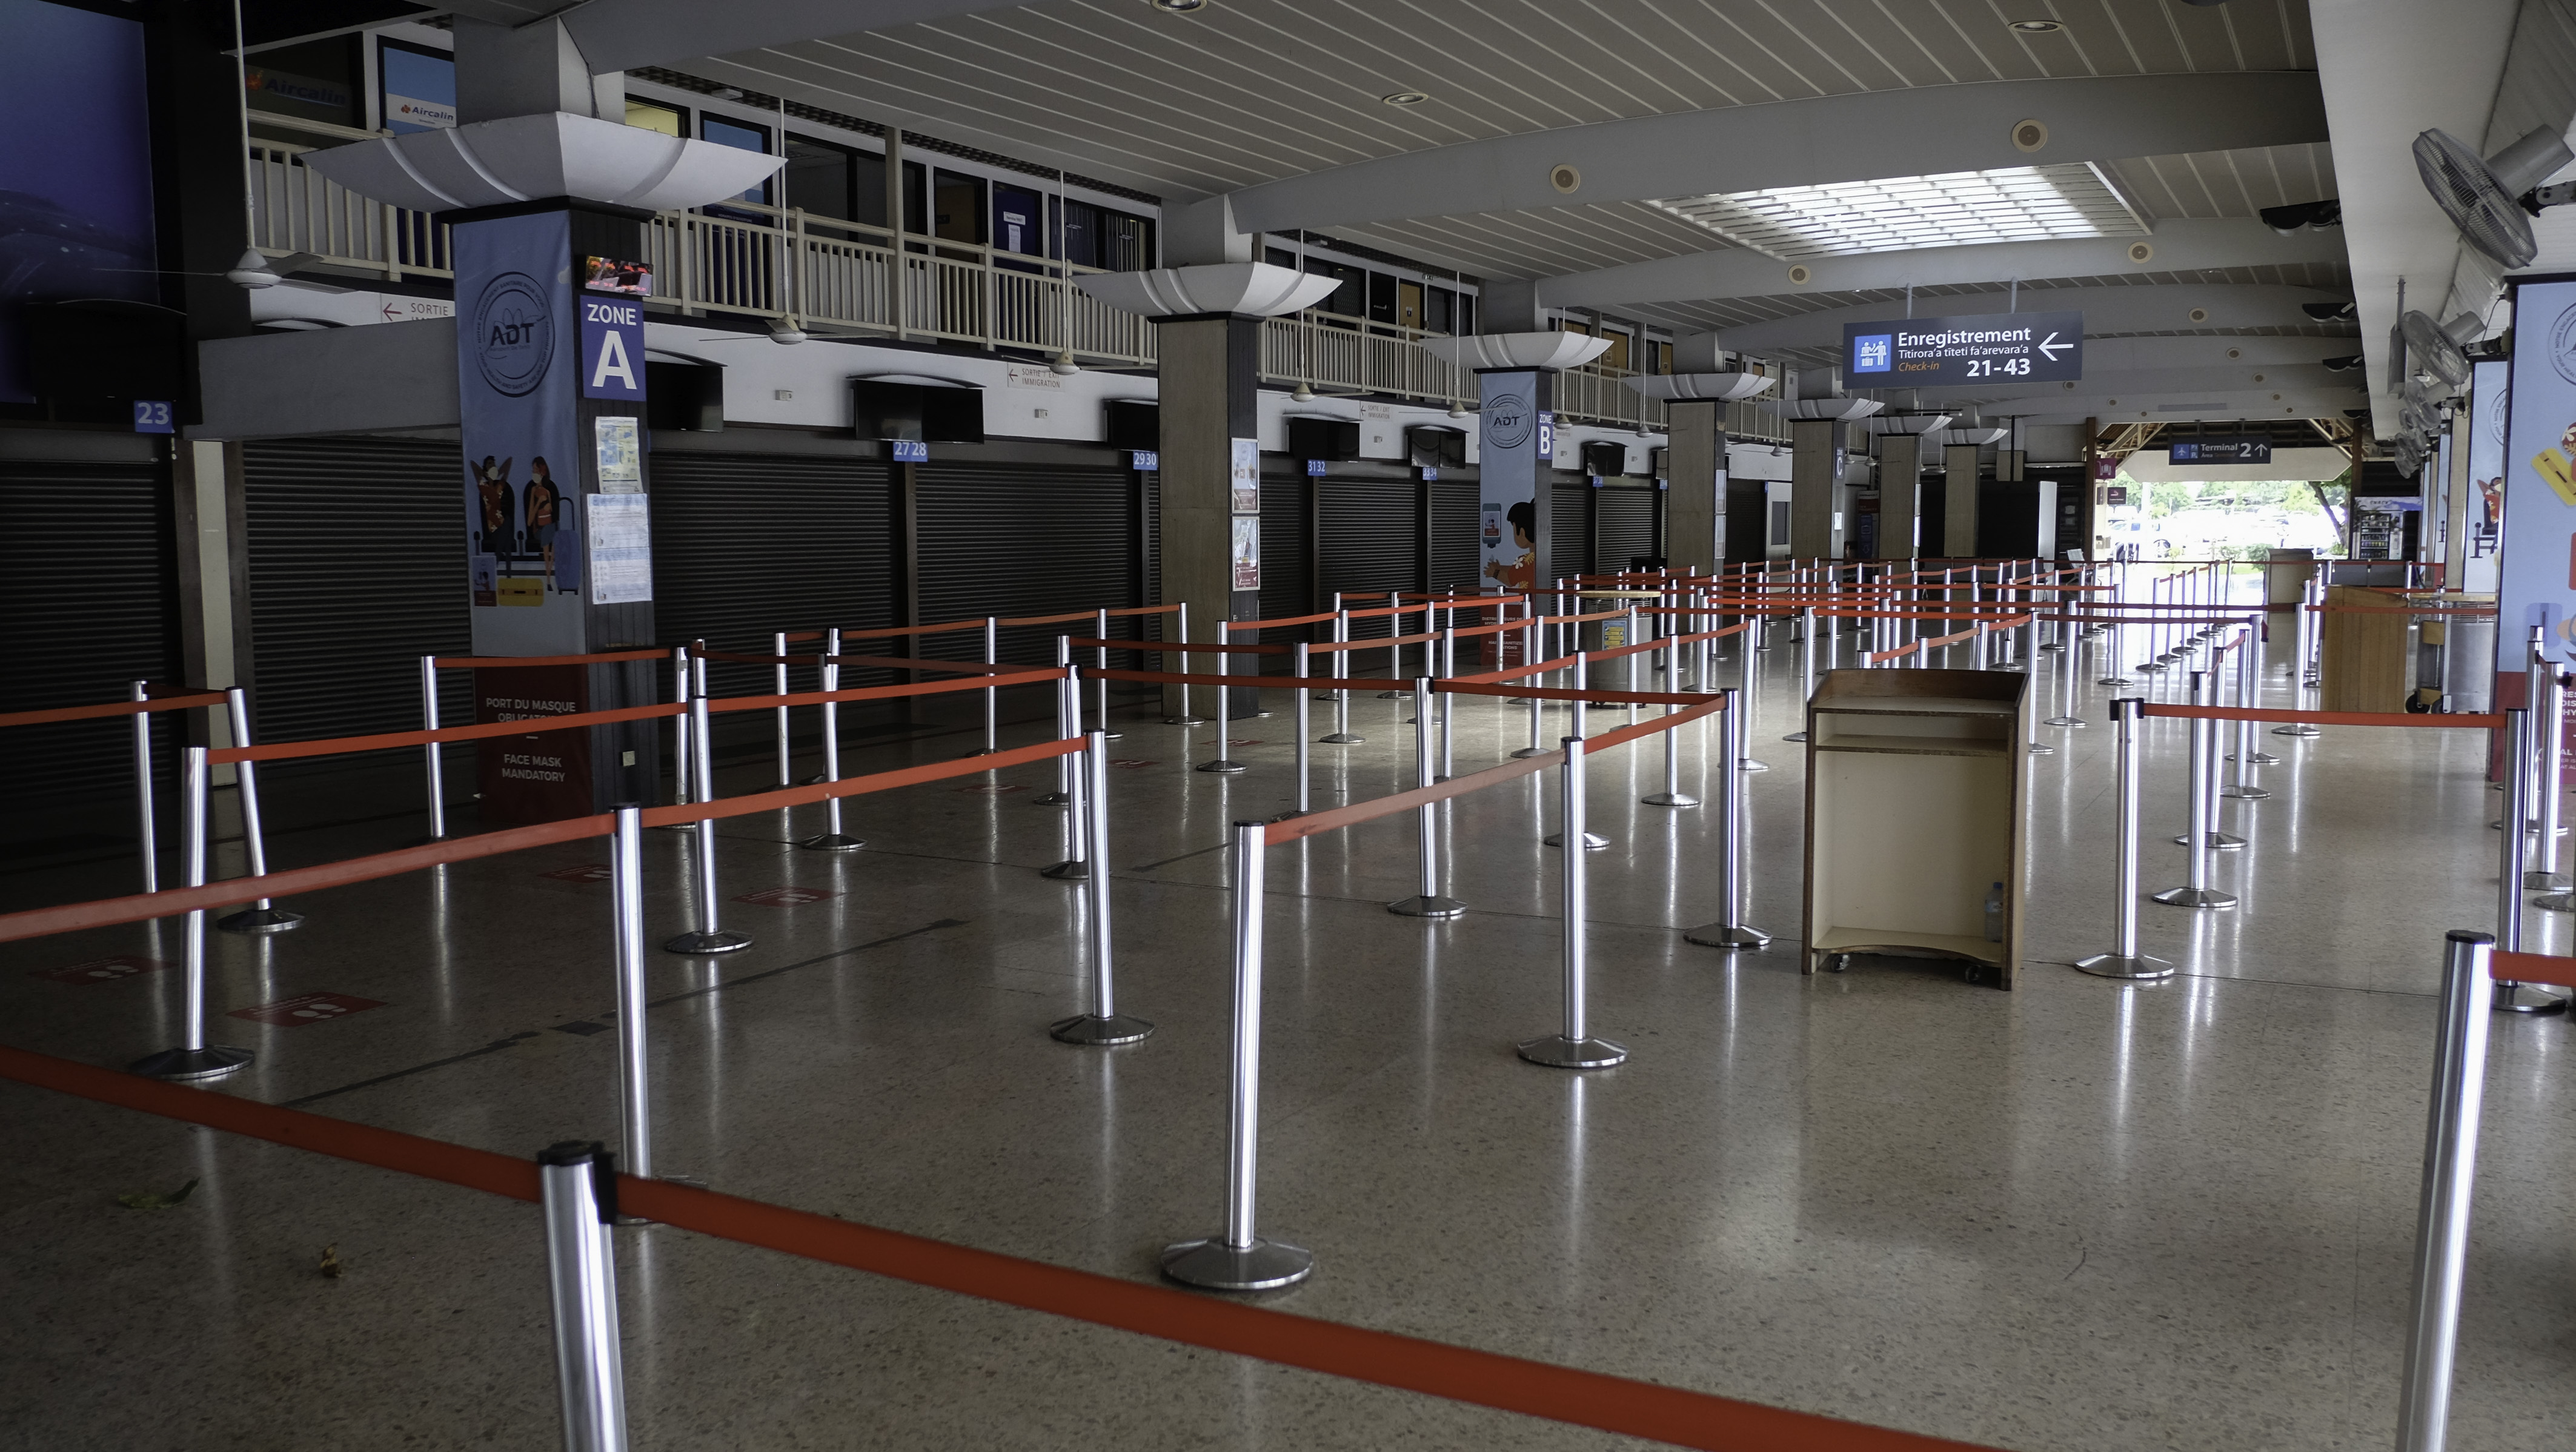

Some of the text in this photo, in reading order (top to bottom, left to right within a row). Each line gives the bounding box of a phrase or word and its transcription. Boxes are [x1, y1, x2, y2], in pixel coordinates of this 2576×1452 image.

[265, 79, 346, 104] Aircalin
[412, 106, 454, 121] Aircalin
[411, 302, 448, 316] SORTIE
[588, 303, 637, 327] ZONE
[491, 323, 535, 346] ADT
[1898, 328, 2031, 348] Enregistrement
[593, 330, 638, 390] A
[1899, 357, 2031, 377] Check-in 21-43
[1022, 368, 1041, 377] SORTIE
[1022, 377, 1060, 388] IMMIGRATION
[137, 402, 170, 425] 23
[1493, 416, 1520, 426] ADT
[1539, 414, 1552, 424] ZONE
[1540, 425, 1551, 455] B
[895, 442, 927, 456] 27 28
[2240, 443, 2252, 458] 2
[1134, 453, 1157, 466] 29 30
[1309, 461, 1326, 472] 31 32
[1837, 456, 1842, 476] C
[486, 697, 576, 714] PORT DU MASQUE
[503, 754, 562, 767] FACE MASK
[502, 767, 566, 782] MANDATORY
